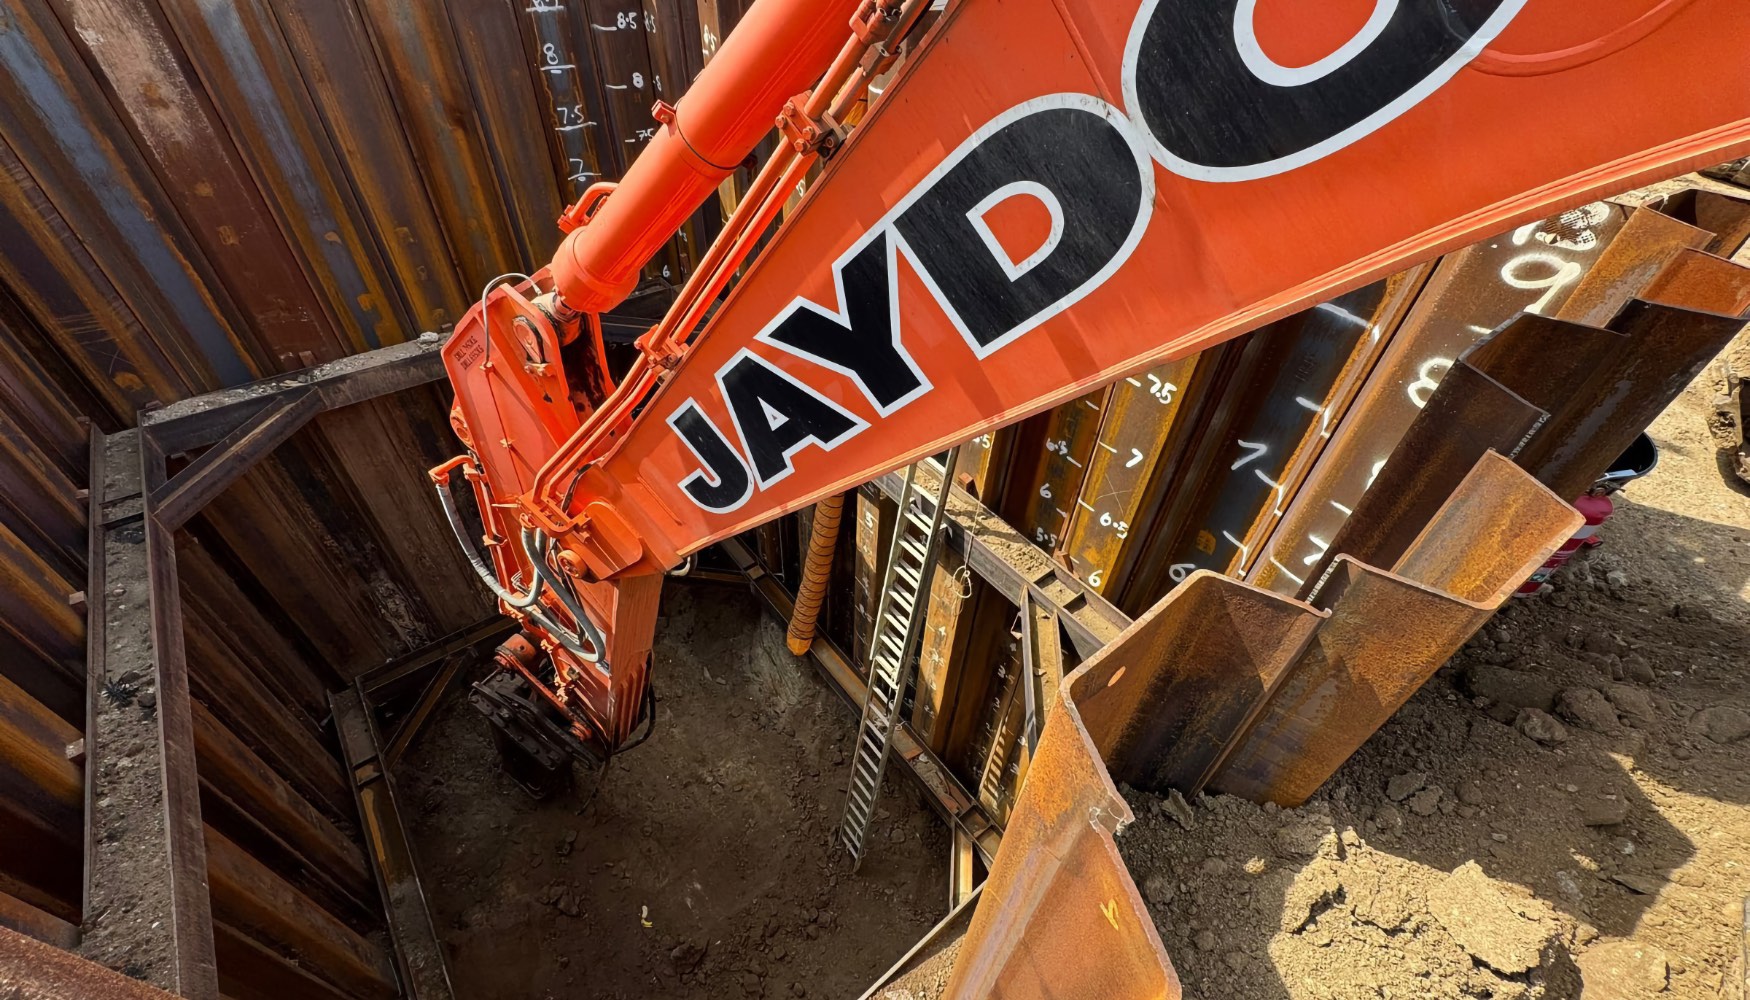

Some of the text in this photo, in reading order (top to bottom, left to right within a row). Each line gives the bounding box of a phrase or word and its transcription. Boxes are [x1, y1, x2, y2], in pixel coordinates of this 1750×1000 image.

[617, 12, 637, 29] 8.5
[643, 11, 657, 33] 8.5
[543, 43, 559, 65] 8
[632, 72, 644, 88] 8
[557, 105, 584, 124] 7.5
[569, 158, 583, 174] 7
[662, 264, 671, 278] 6
[1501, 253, 1582, 315] 9
[1148, 373, 1178, 404] 7.5
[1046, 437, 1068, 455] 6.5
[1231, 439, 1268, 471] 7
[1125, 448, 1144, 468] 7
[1040, 483, 1052, 499] 6
[1100, 512, 1128, 540] 6.5
[1036, 527, 1058, 547] 5.5
[1088, 569, 1103, 587] 6
[1168, 563, 1197, 583] 6
